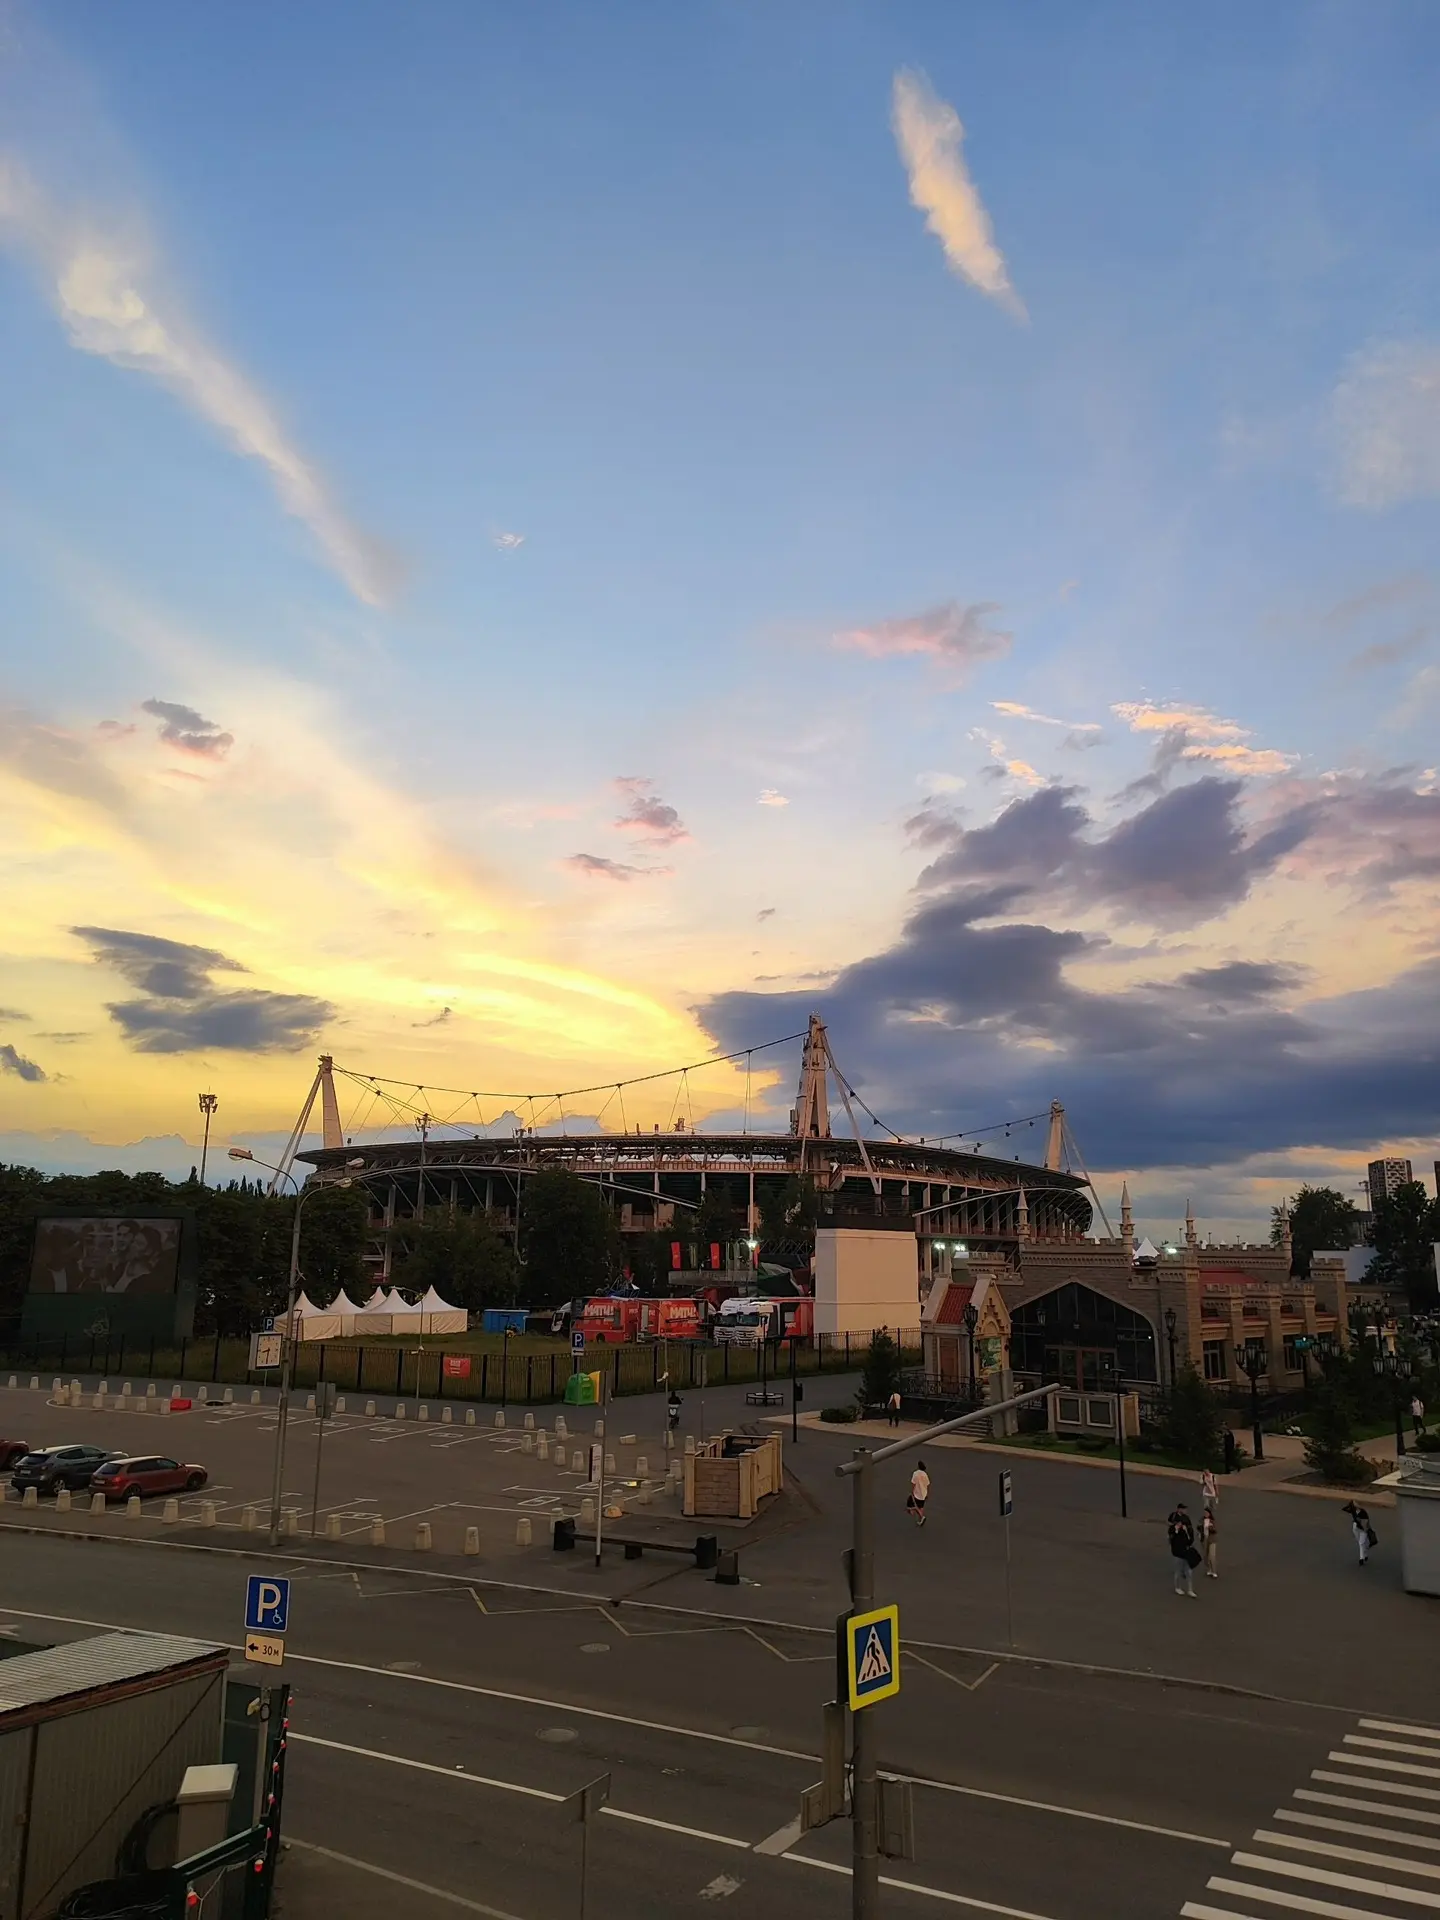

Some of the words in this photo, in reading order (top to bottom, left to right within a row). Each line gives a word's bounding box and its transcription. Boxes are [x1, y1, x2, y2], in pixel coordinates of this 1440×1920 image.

[266, 1319, 273, 1329] P
[575, 1334, 582, 1346] P
[258, 1584, 281, 1623] P
